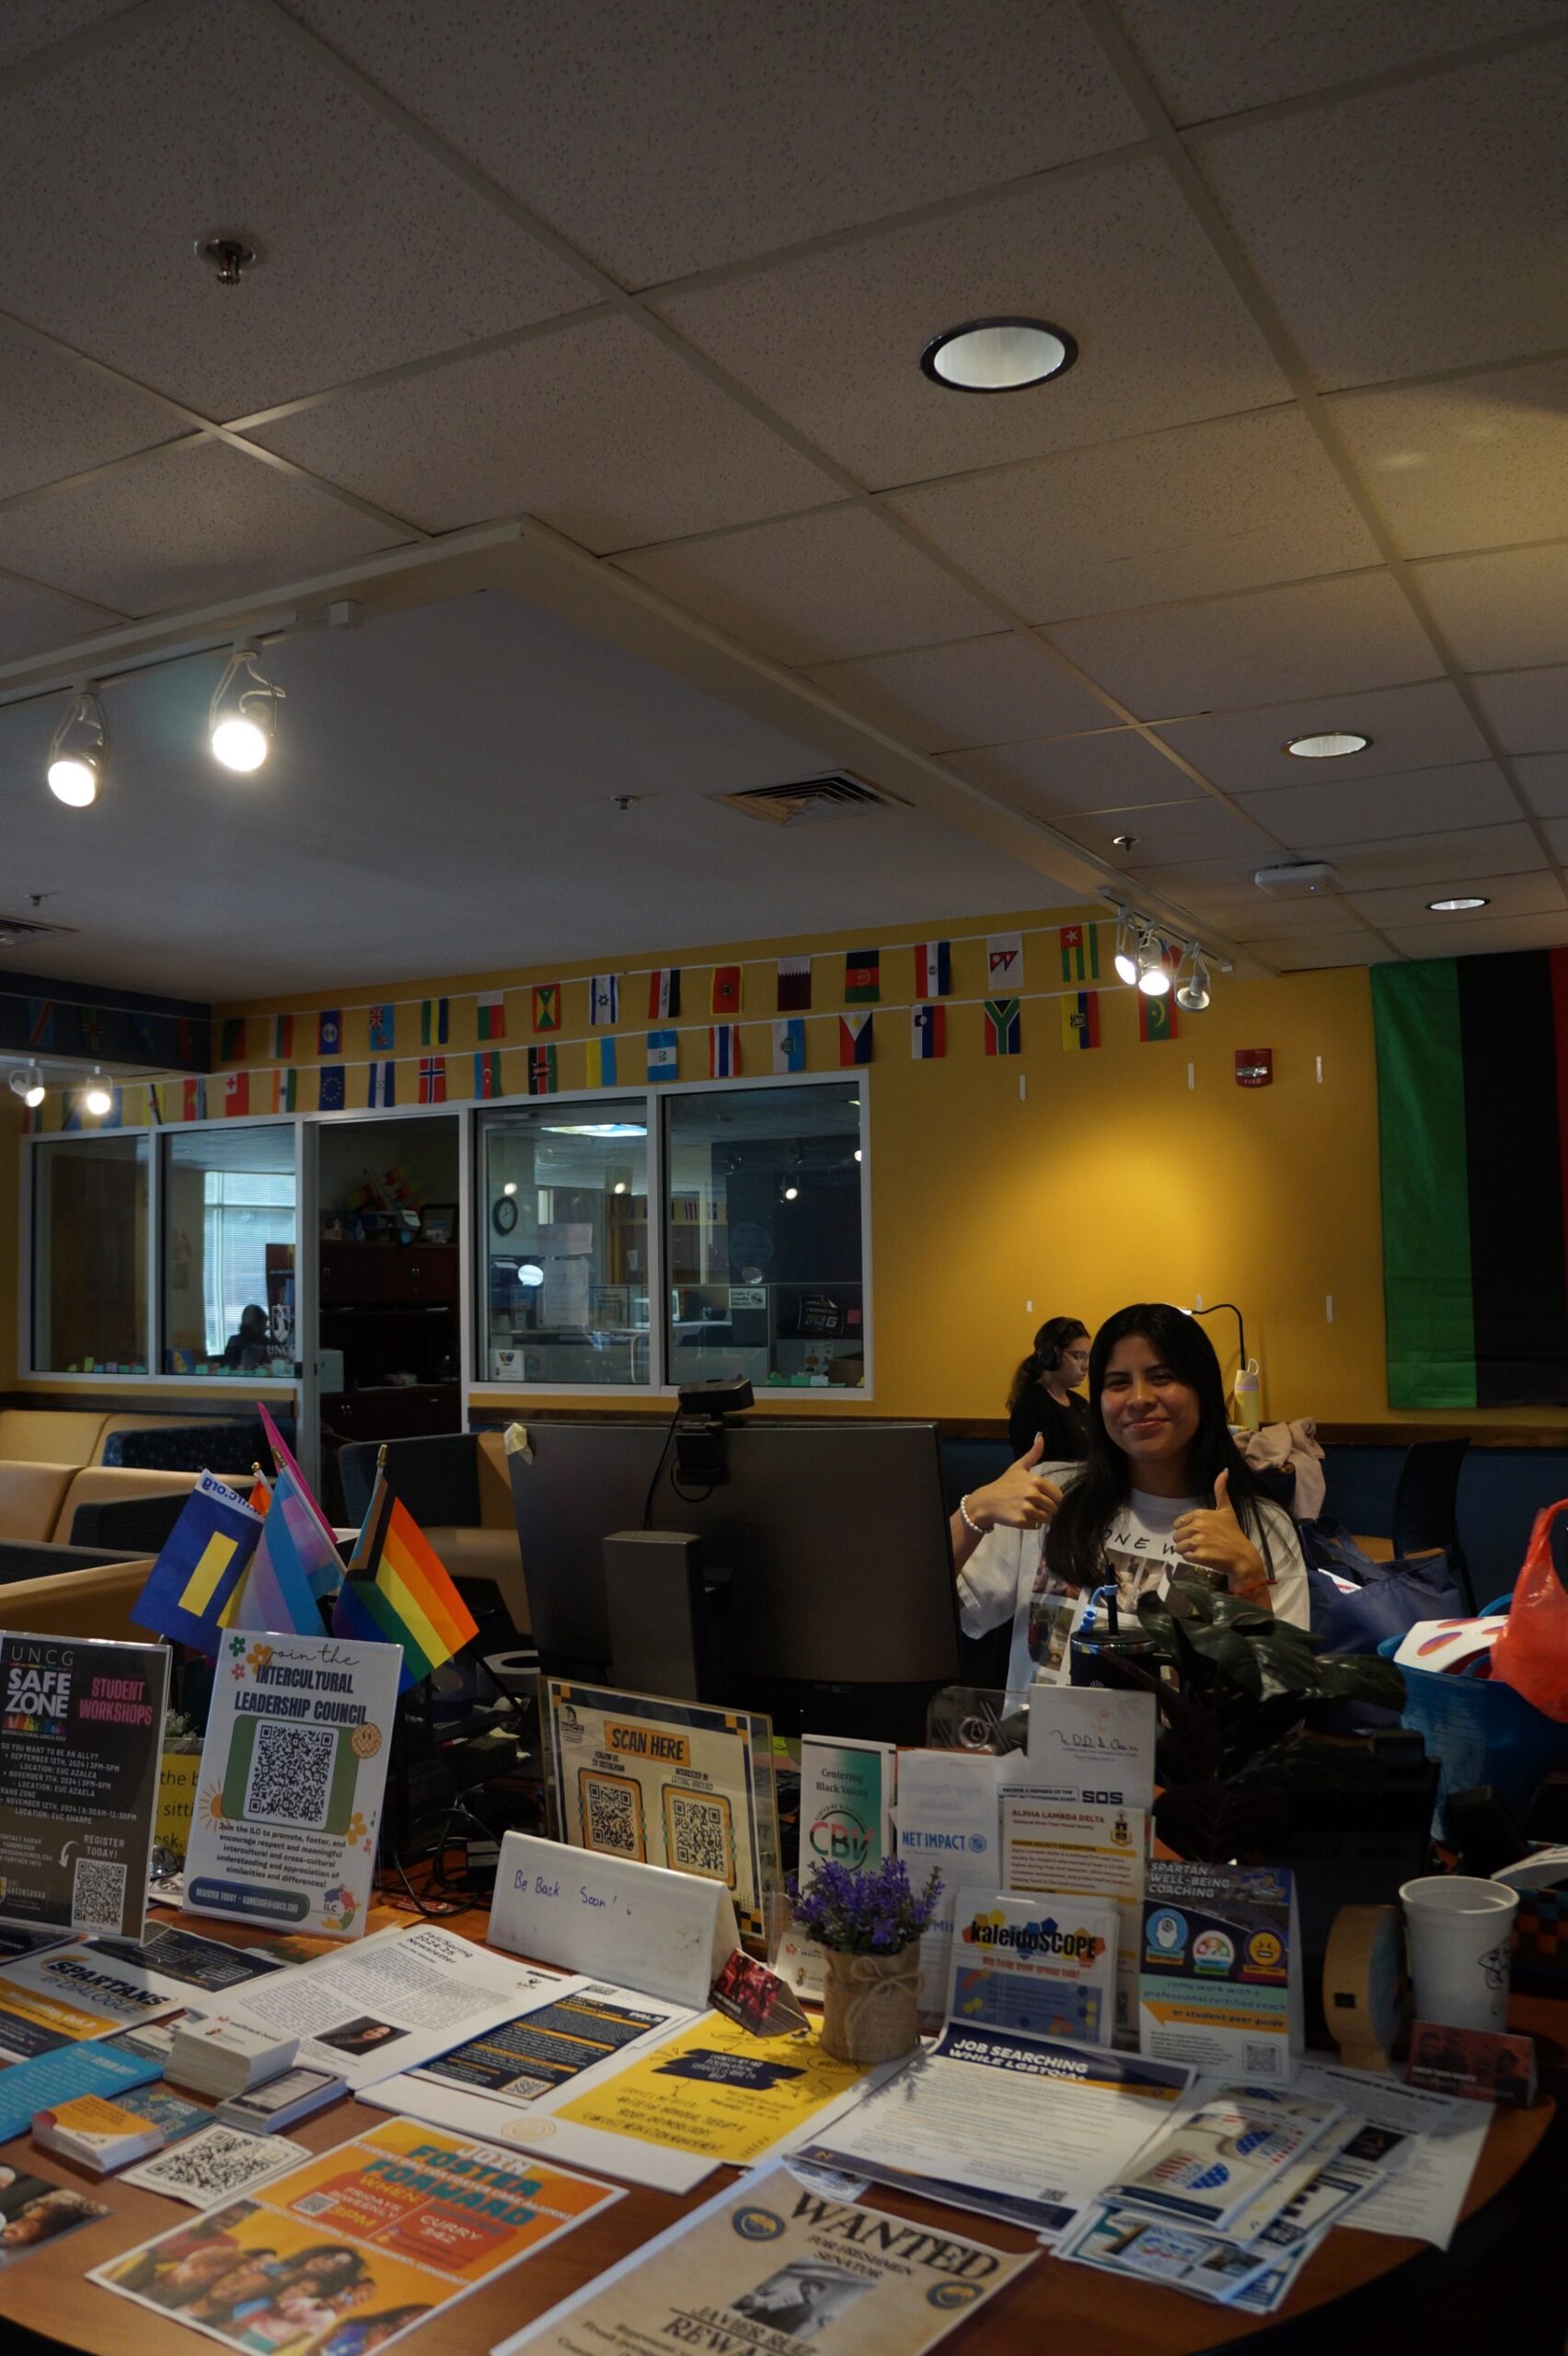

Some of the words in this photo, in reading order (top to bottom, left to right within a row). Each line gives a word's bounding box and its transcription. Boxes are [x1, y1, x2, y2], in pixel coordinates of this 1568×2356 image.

[11, 1646, 75, 1667] UNCG
[317, 1644, 360, 1666] the
[8, 1668, 72, 1694] SAFE
[92, 1677, 145, 1701] STUDENT
[255, 1665, 354, 1693] INTERCULTURAL
[5, 1690, 69, 1717] ZONE
[78, 1698, 153, 1726] WORKSHOPS
[234, 1691, 311, 1717] LEADERSHIP
[314, 1700, 367, 1725] COUNCIL
[560, 1722, 584, 1735] UNCG
[12, 1743, 24, 1751] YOU
[26, 1745, 44, 1754] WANT
[66, 1750, 76, 1758] AN
[78, 1751, 99, 1760] ALLY?
[612, 1728, 647, 1754] SCAN
[651, 1735, 684, 1761] HERE
[10, 1752, 50, 1763] SEPTEMBER
[8, 1771, 43, 1781] NOVEMBER
[61, 1777, 76, 1785] 2024
[20, 1763, 54, 1773] LOCATION:
[70, 1769, 97, 1779] AZALEA
[160, 1770, 186, 1786] the
[821, 1768, 864, 1784] Centering
[0, 1787, 17, 1796] RANS
[19, 1789, 36, 1798] ZONE
[18, 1782, 53, 1792] LOCATION:
[816, 1781, 839, 1794] Black
[841, 1785, 868, 1797] Voices
[6, 1797, 40, 1808] NOVEMBER
[1082, 1790, 1124, 1805] SOS
[15, 1807, 49, 1819] LOCATION:
[66, 1814, 92, 1824] SHARPE
[1012, 1809, 1041, 1819] ALPHA
[1043, 1811, 1078, 1821] LAMBDA
[1078, 1815, 1104, 1823] DELTA
[84, 1833, 124, 1848] REGISTER
[219, 1822, 234, 1831] Join
[236, 1824, 248, 1833] the
[249, 1826, 261, 1835] ILC
[263, 1829, 271, 1837] to
[272, 1831, 304, 1842] promote,
[306, 1835, 330, 1846] foster,
[332, 1840, 346, 1848] and
[810, 1820, 875, 1861] CBV
[902, 1831, 921, 1848] NET
[925, 1833, 966, 1851] IMPACT
[86, 1846, 118, 1859] TODAY!
[219, 1834, 256, 1846] encourage
[258, 1840, 285, 1850] respect
[286, 1843, 300, 1852] and
[301, 1846, 342, 1858] meaningful
[224, 1843, 268, 1857] intercultural
[270, 1850, 282, 1859] and
[283, 1854, 336, 1867] cross-cultural
[216, 1854, 268, 1868] understanding
[269, 1861, 282, 1870] and
[283, 1864, 329, 1877] appreciation
[1150, 1862, 1208, 1876] SPARTAN
[226, 1866, 266, 1877] similarities
[267, 1872, 281, 1880] and
[282, 1875, 327, 1888] differences!
[514, 1869, 528, 1892] Be
[536, 1877, 559, 1898] Back
[1150, 1873, 1230, 1888] WELL-BEING
[196, 1887, 220, 1900] REGISTER
[220, 1892, 237, 1904] TODAY
[1148, 1884, 1215, 1898] COACHING
[323, 1902, 337, 1912] ILC
[406, 1938, 456, 1964] Newsletter
[47, 1961, 172, 2006] SPARTANS
[57, 1979, 138, 2015] DIALOGUE
[1143, 1991, 1207, 2003] professional
[1185, 2009, 1227, 2021] student
[949, 2048, 1004, 2066] WHILE
[953, 2038, 989, 2055] JOB
[991, 2045, 1089, 2074] SEARCHING
[455, 2145, 535, 2175] JOIN
[403, 2144, 543, 2197] FOSTER
[359, 2159, 538, 2225] FORWARD
[419, 2227, 457, 2243] 342
[420, 2214, 482, 2240] CURRY
[791, 2191, 999, 2281] WANTED
[814, 2250, 883, 2280] SENATOR
